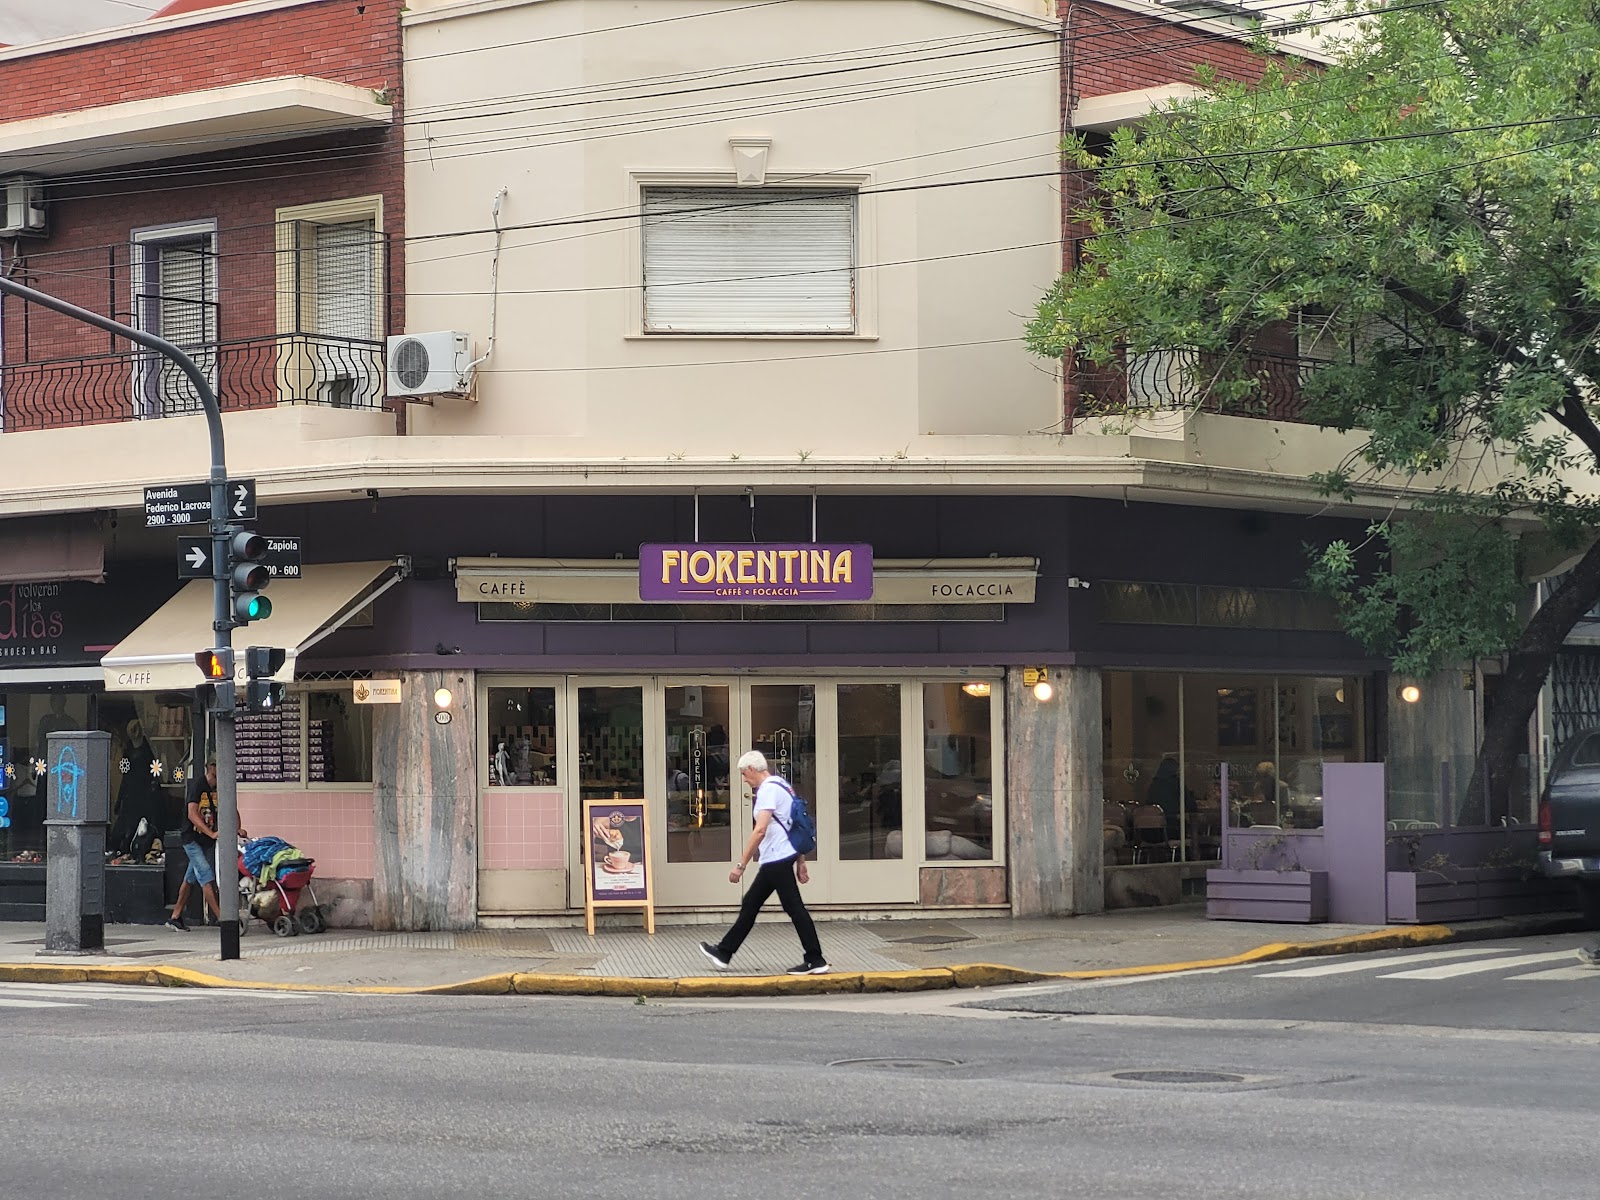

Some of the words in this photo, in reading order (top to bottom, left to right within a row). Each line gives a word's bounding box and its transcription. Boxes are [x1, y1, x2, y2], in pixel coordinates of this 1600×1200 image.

[146, 488, 178, 500] Avenida
[145, 503, 179, 514] Federico
[180, 500, 211, 511] Lacroze
[146, 515, 166, 525] 2900
[172, 513, 191, 523] 3000
[267, 540, 298, 552] Zapiola
[263, 565, 277, 575] 00
[283, 565, 299, 575] 600
[661, 550, 853, 584] FIORENTINA
[18, 582, 59, 598] volverán
[479, 580, 526, 595] CAFFÈ
[715, 587, 742, 596] CAFFÈ
[752, 588, 799, 596] FOCACCIA
[932, 584, 1014, 597] FOCACCIA
[29, 599, 42, 612] los
[30, 647, 35, 655] &
[40, 645, 57, 655] BAG
[118, 670, 151, 685] CAFFÈ
